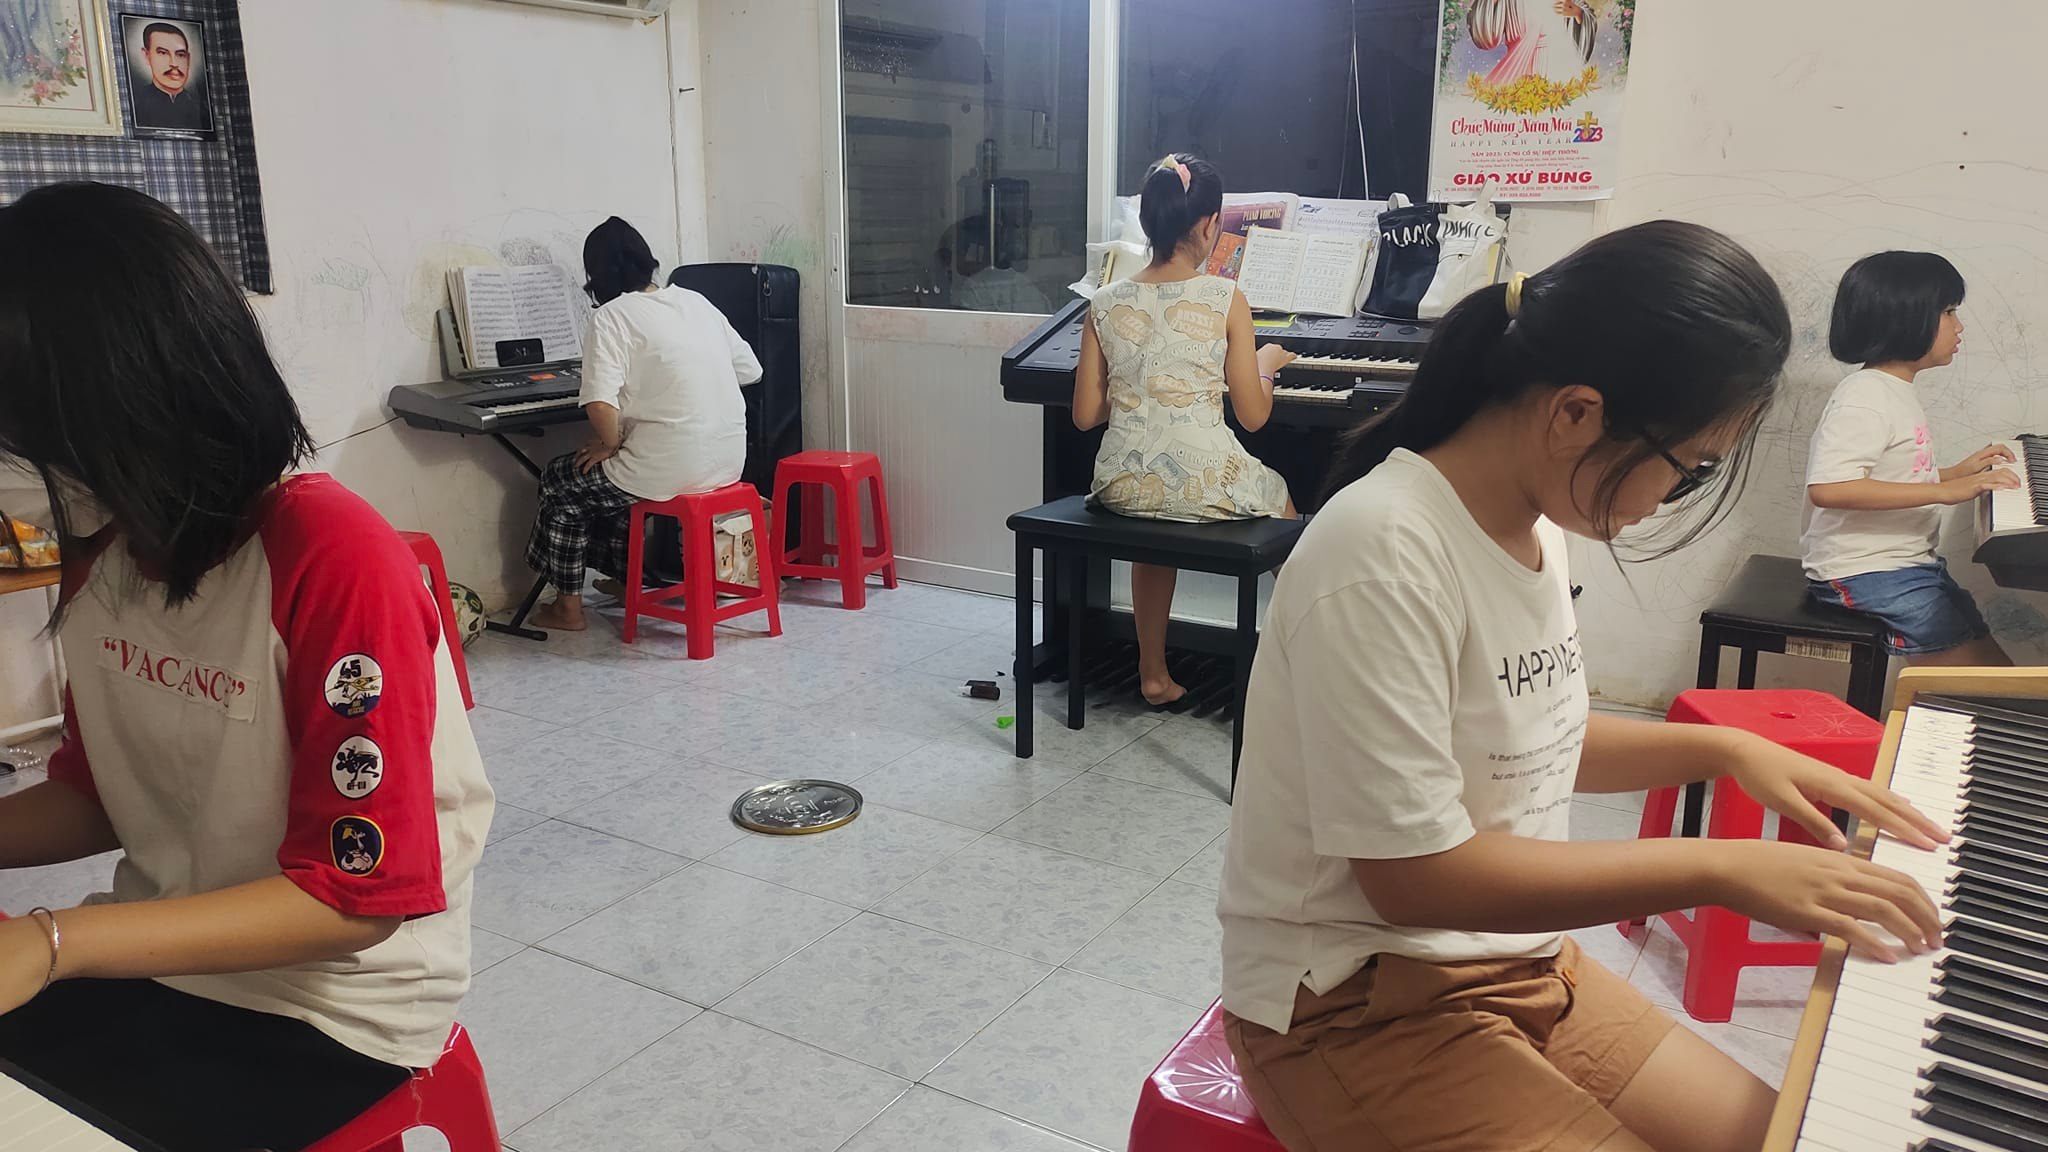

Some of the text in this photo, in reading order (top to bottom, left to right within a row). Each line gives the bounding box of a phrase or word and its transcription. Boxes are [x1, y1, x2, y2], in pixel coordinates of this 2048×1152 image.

[1450, 140, 1492, 148] HAPPY
[1505, 168, 1534, 185] XỨ
[1538, 168, 1593, 184] BÚNG
